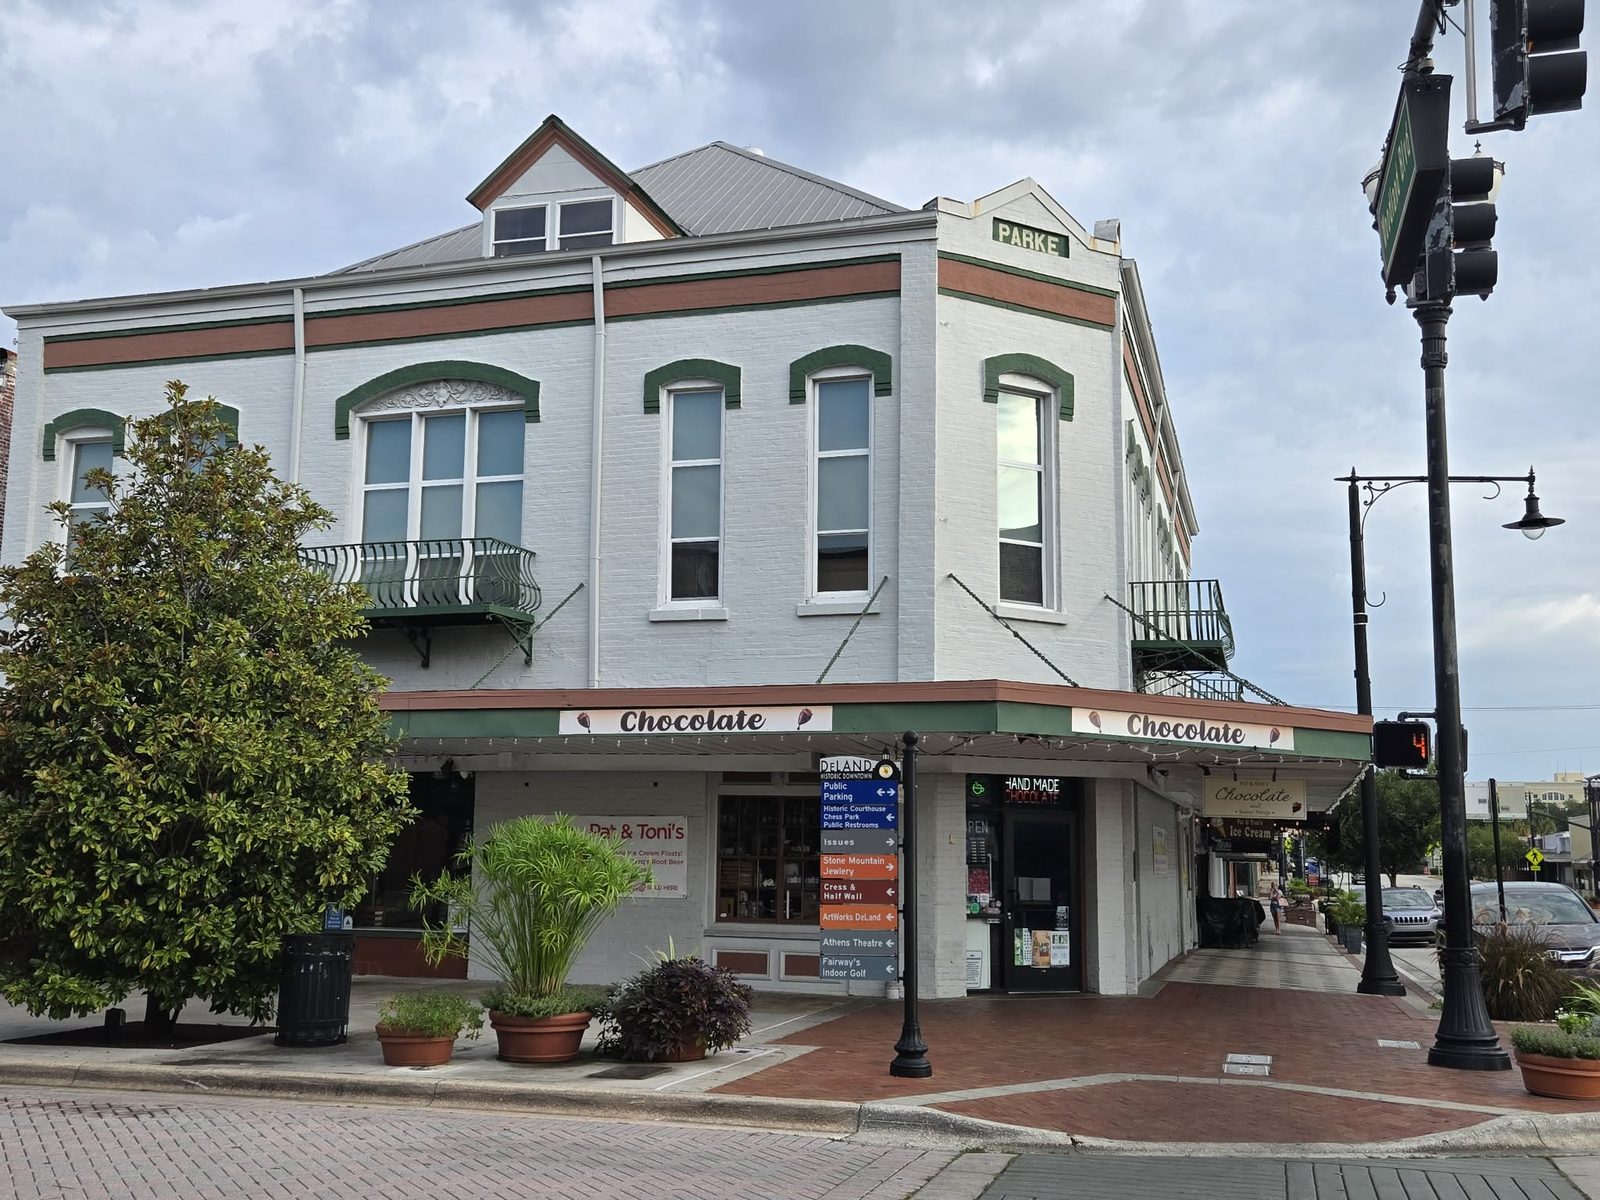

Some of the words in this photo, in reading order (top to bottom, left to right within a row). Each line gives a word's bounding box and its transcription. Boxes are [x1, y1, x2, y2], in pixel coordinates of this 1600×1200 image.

[999, 223, 1059, 256] PARKE
[620, 709, 767, 732] Chocolate
[1127, 713, 1246, 744] Chocolate
[1413, 733, 1426, 759] 4
[823, 782, 848, 790] Public
[1033, 778, 1060, 792] MADE
[823, 792, 853, 802] Parking
[1215, 786, 1293, 802] Chocolate
[844, 821, 879, 829] Restrooms
[968, 820, 989, 833] PEN
[621, 824, 633, 839] &
[636, 823, 685, 840] Toni's
[1230, 826, 1242, 837] Ice
[1244, 826, 1272, 838] Cream
[824, 838, 855, 846] Issues
[823, 856, 846, 865] Stone
[848, 856, 885, 865] Mountain
[823, 883, 847, 891] Cress
[850, 883, 856, 891] &
[823, 892, 842, 900] Half
[843, 892, 863, 900] Wall
[855, 913, 881, 921] DeLand
[822, 938, 850, 947] Athens
[852, 938, 883, 947] Theatre
[822, 957, 861, 967] Fairway's
[822, 968, 848, 977] Indoor
[850, 969, 867, 978] Golf
